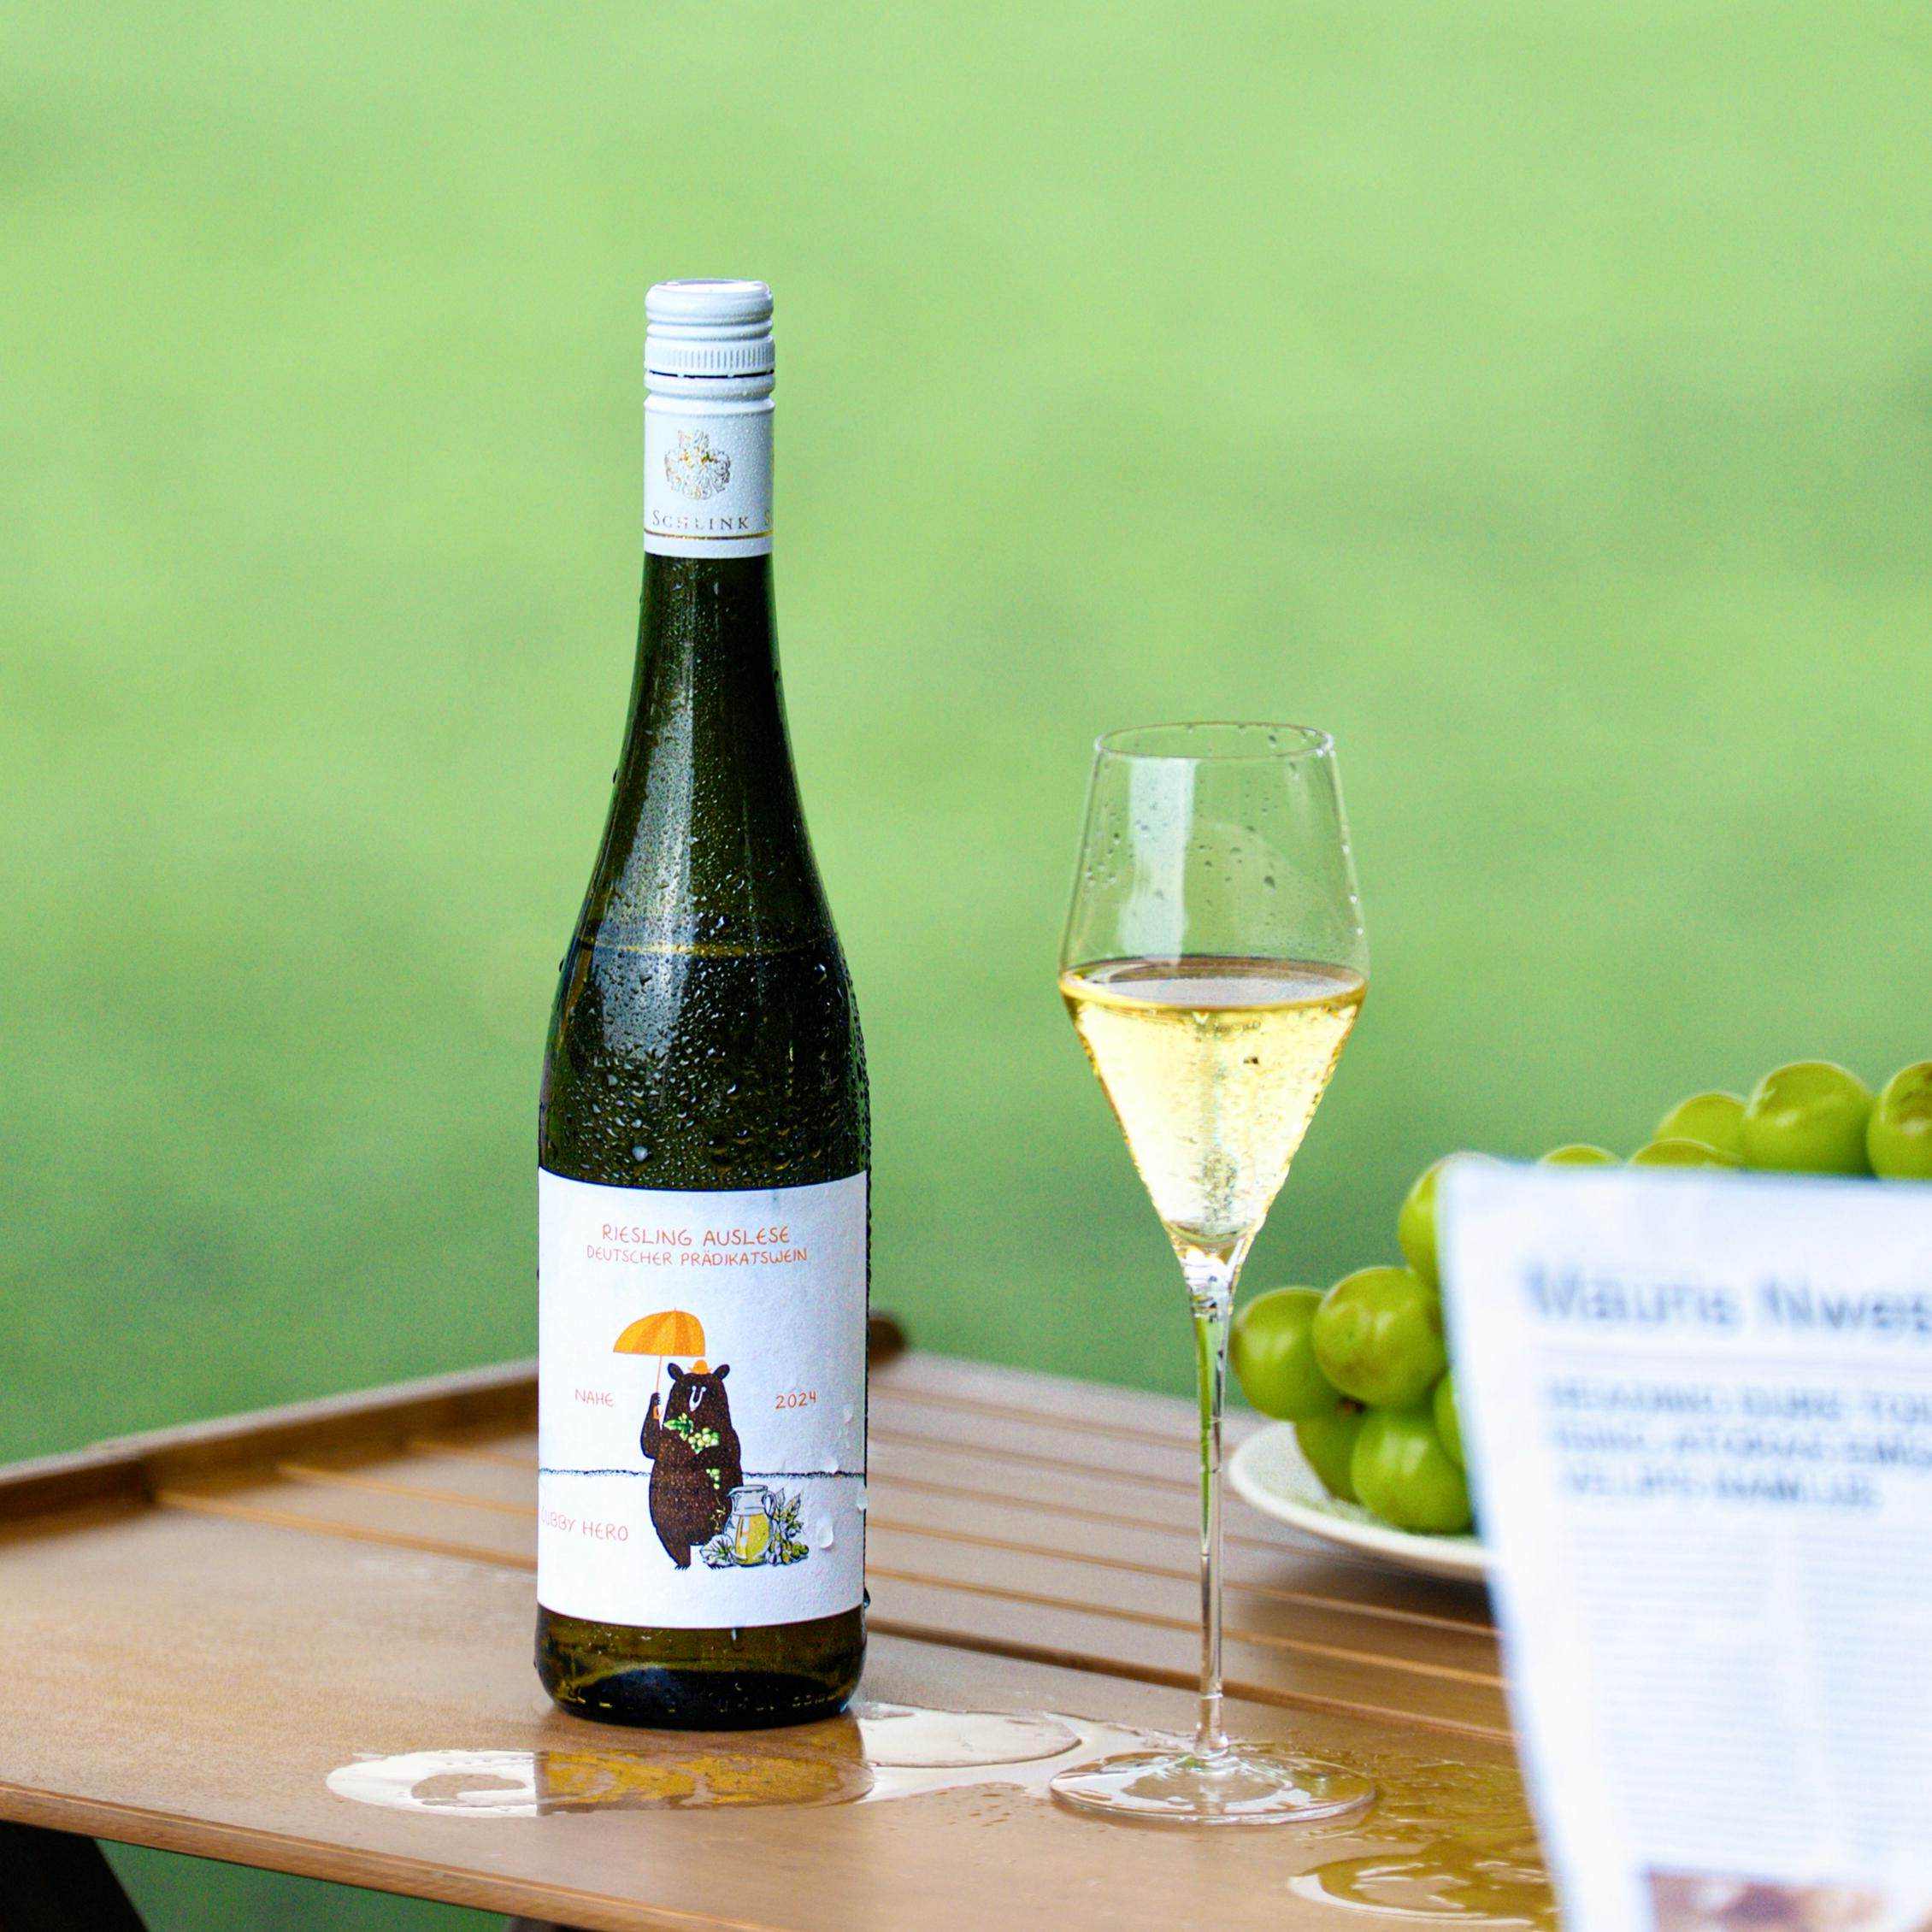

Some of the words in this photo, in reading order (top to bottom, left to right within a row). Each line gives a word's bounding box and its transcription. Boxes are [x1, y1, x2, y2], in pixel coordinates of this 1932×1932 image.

[651, 510, 749, 530] SCHLINK
[602, 1223, 692, 1246] RIESLING
[703, 1225, 791, 1246] AUSLESE
[586, 1245, 672, 1265] DEUTSCHER
[680, 1247, 808, 1267] PRÄDIKATSWEIN
[574, 1388, 614, 1408] NAHE
[775, 1390, 816, 1410] 2024
[582, 1520, 629, 1542] HERO
